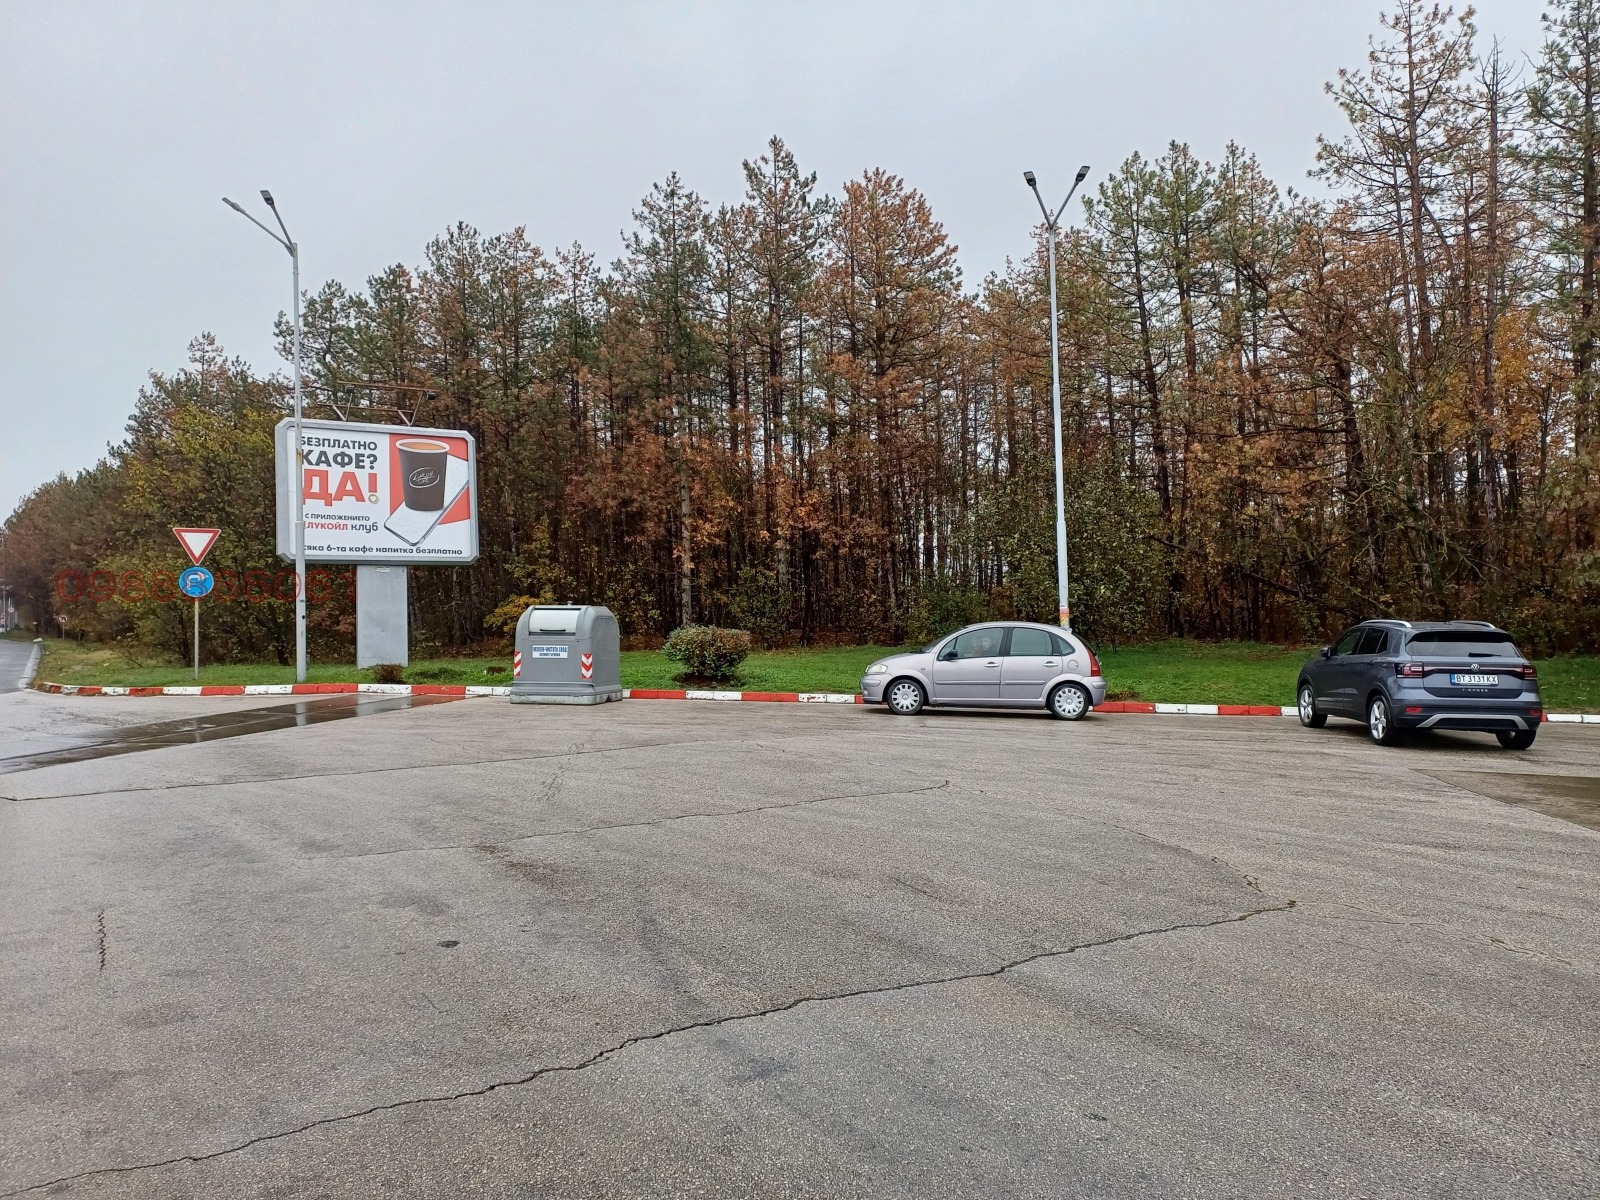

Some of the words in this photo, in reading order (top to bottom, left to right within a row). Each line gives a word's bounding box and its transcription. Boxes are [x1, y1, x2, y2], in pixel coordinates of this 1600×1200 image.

[301, 436, 378, 451] БЕЗПЛАТНО
[301, 449, 378, 470] КАФЕ?
[302, 468, 379, 507] ДА!
[311, 513, 370, 521] ПРИЛОЖЕНИЕТО
[306, 521, 348, 531] ЛУКОЙЛ
[351, 521, 379, 534] клуб
[326, 544, 347, 552] 6-та
[348, 545, 374, 554] кафе
[415, 546, 463, 555] безплатно
